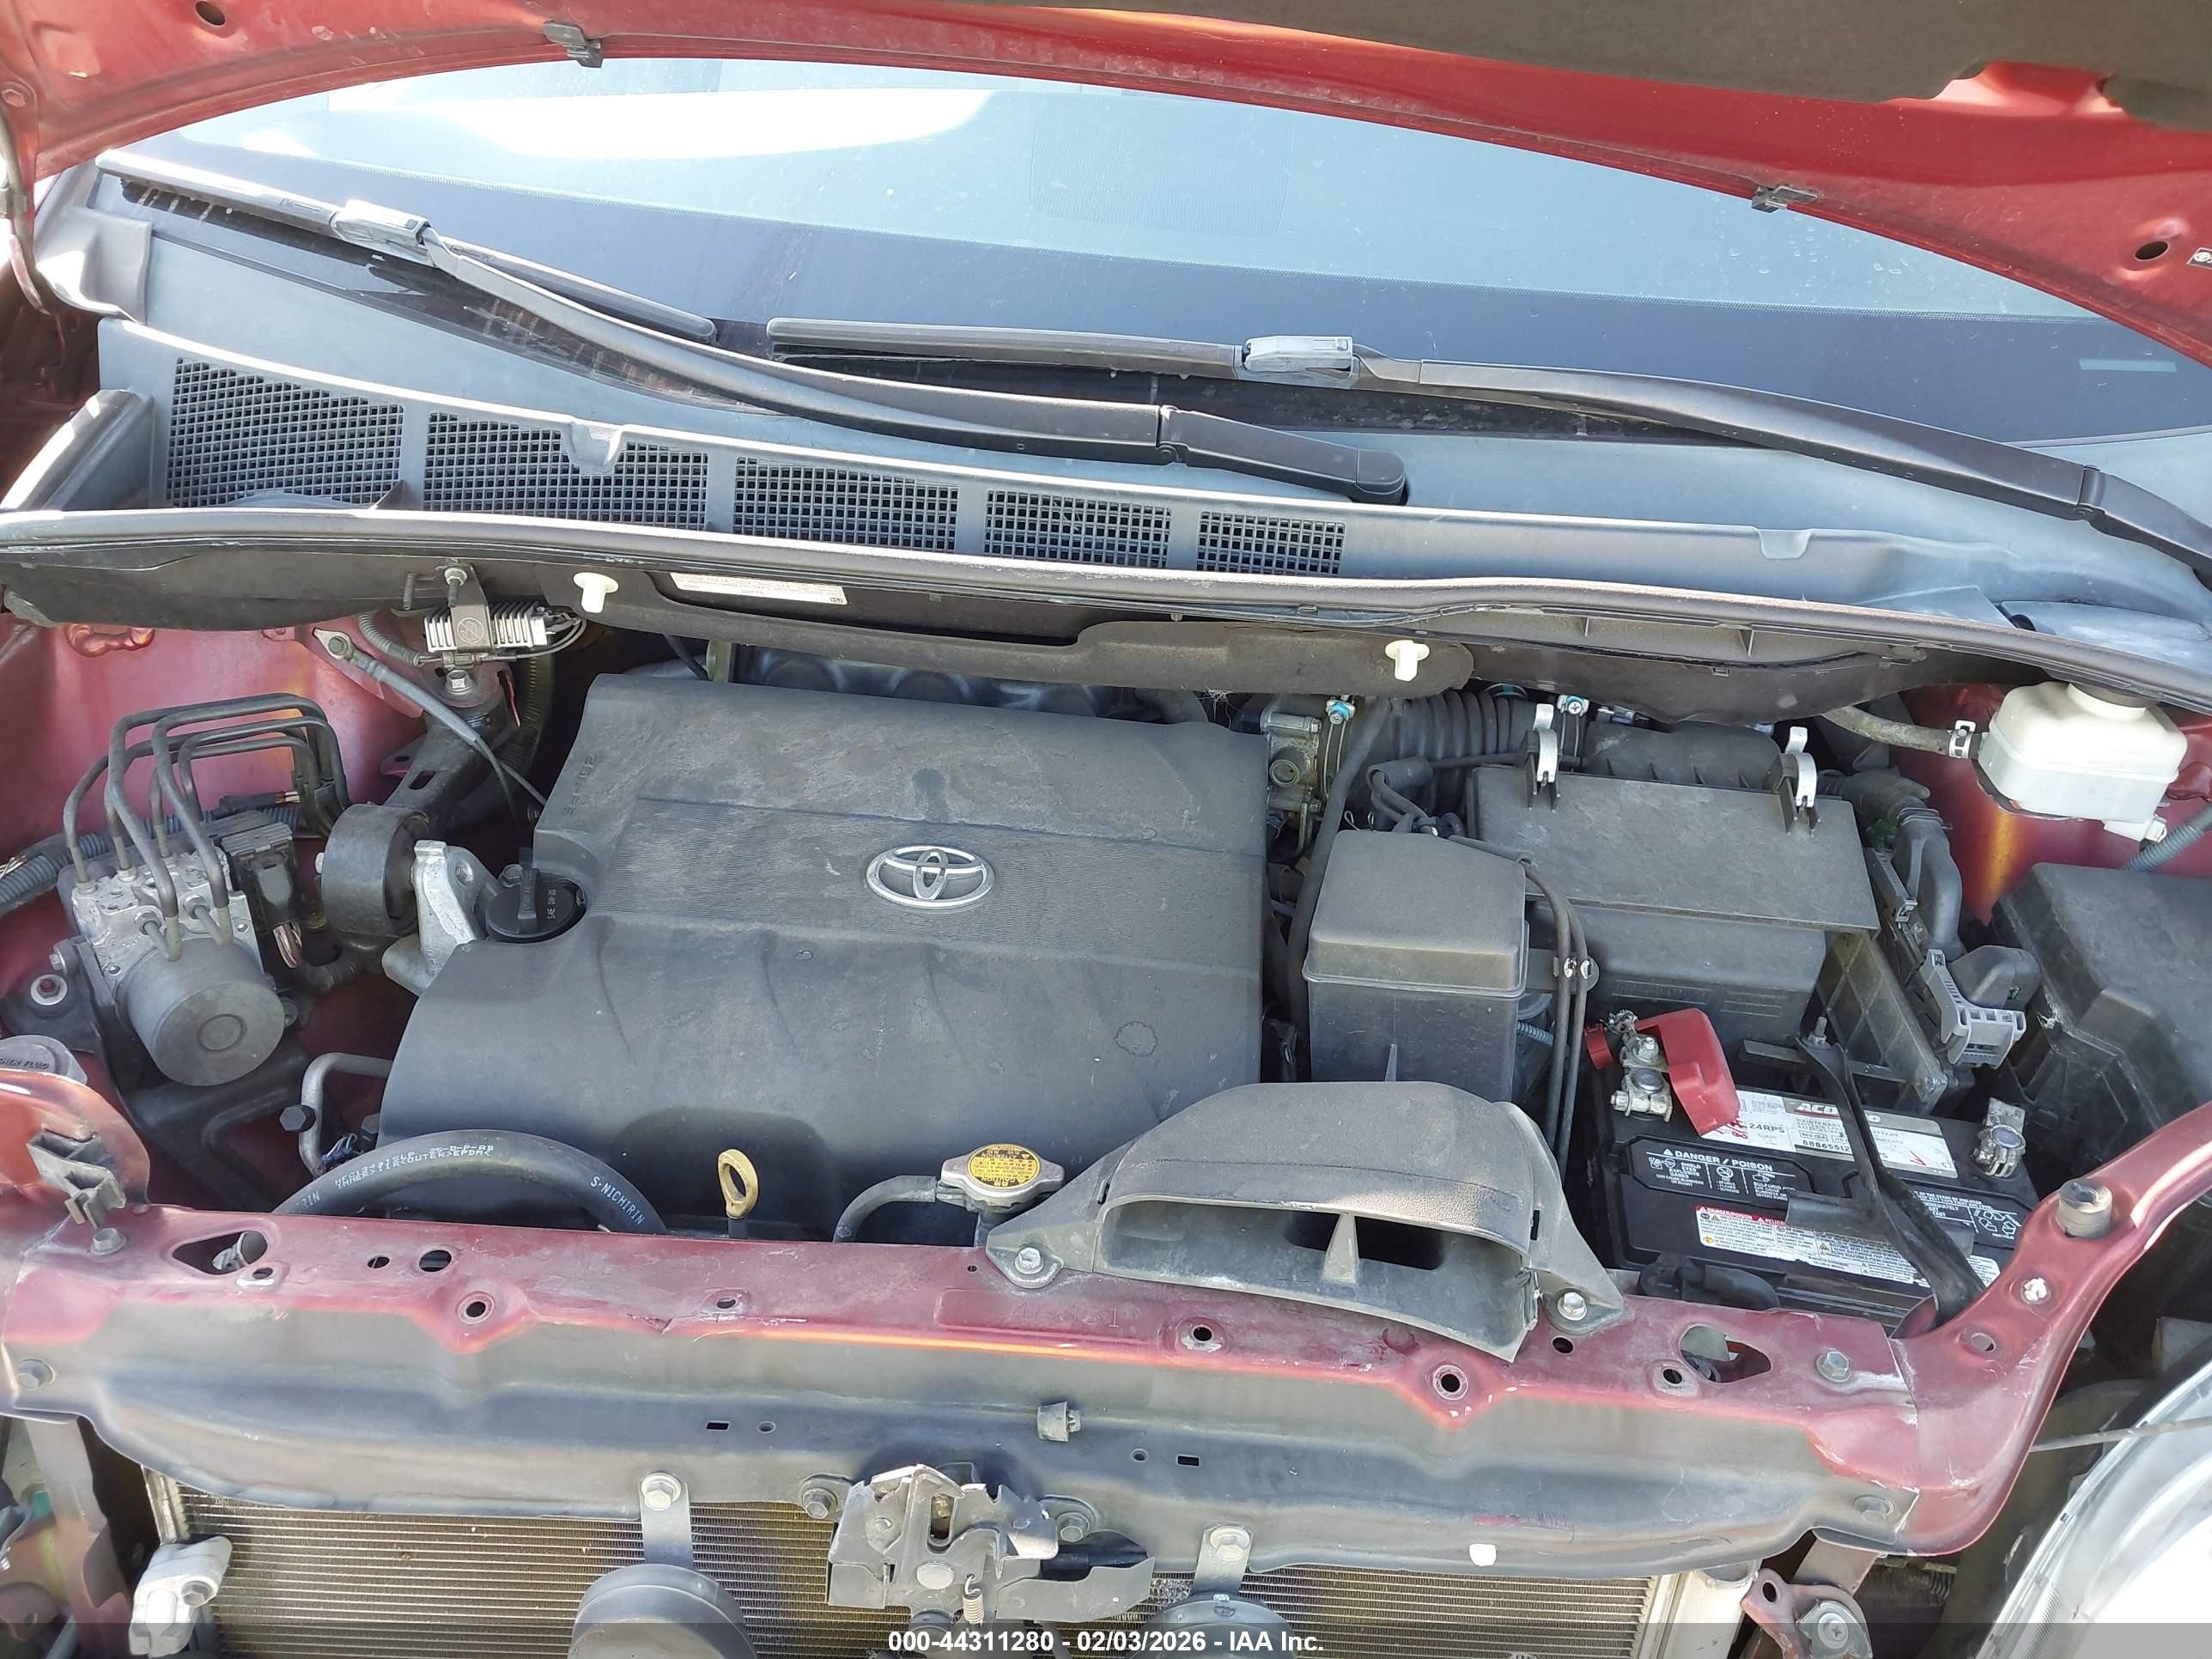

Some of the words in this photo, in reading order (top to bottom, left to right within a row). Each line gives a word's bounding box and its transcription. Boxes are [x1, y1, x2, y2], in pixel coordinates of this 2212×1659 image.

[547, 906, 556, 921] SAE
[1675, 1151, 1719, 1164] DANGER
[1732, 1159, 1773, 1171] POISON
